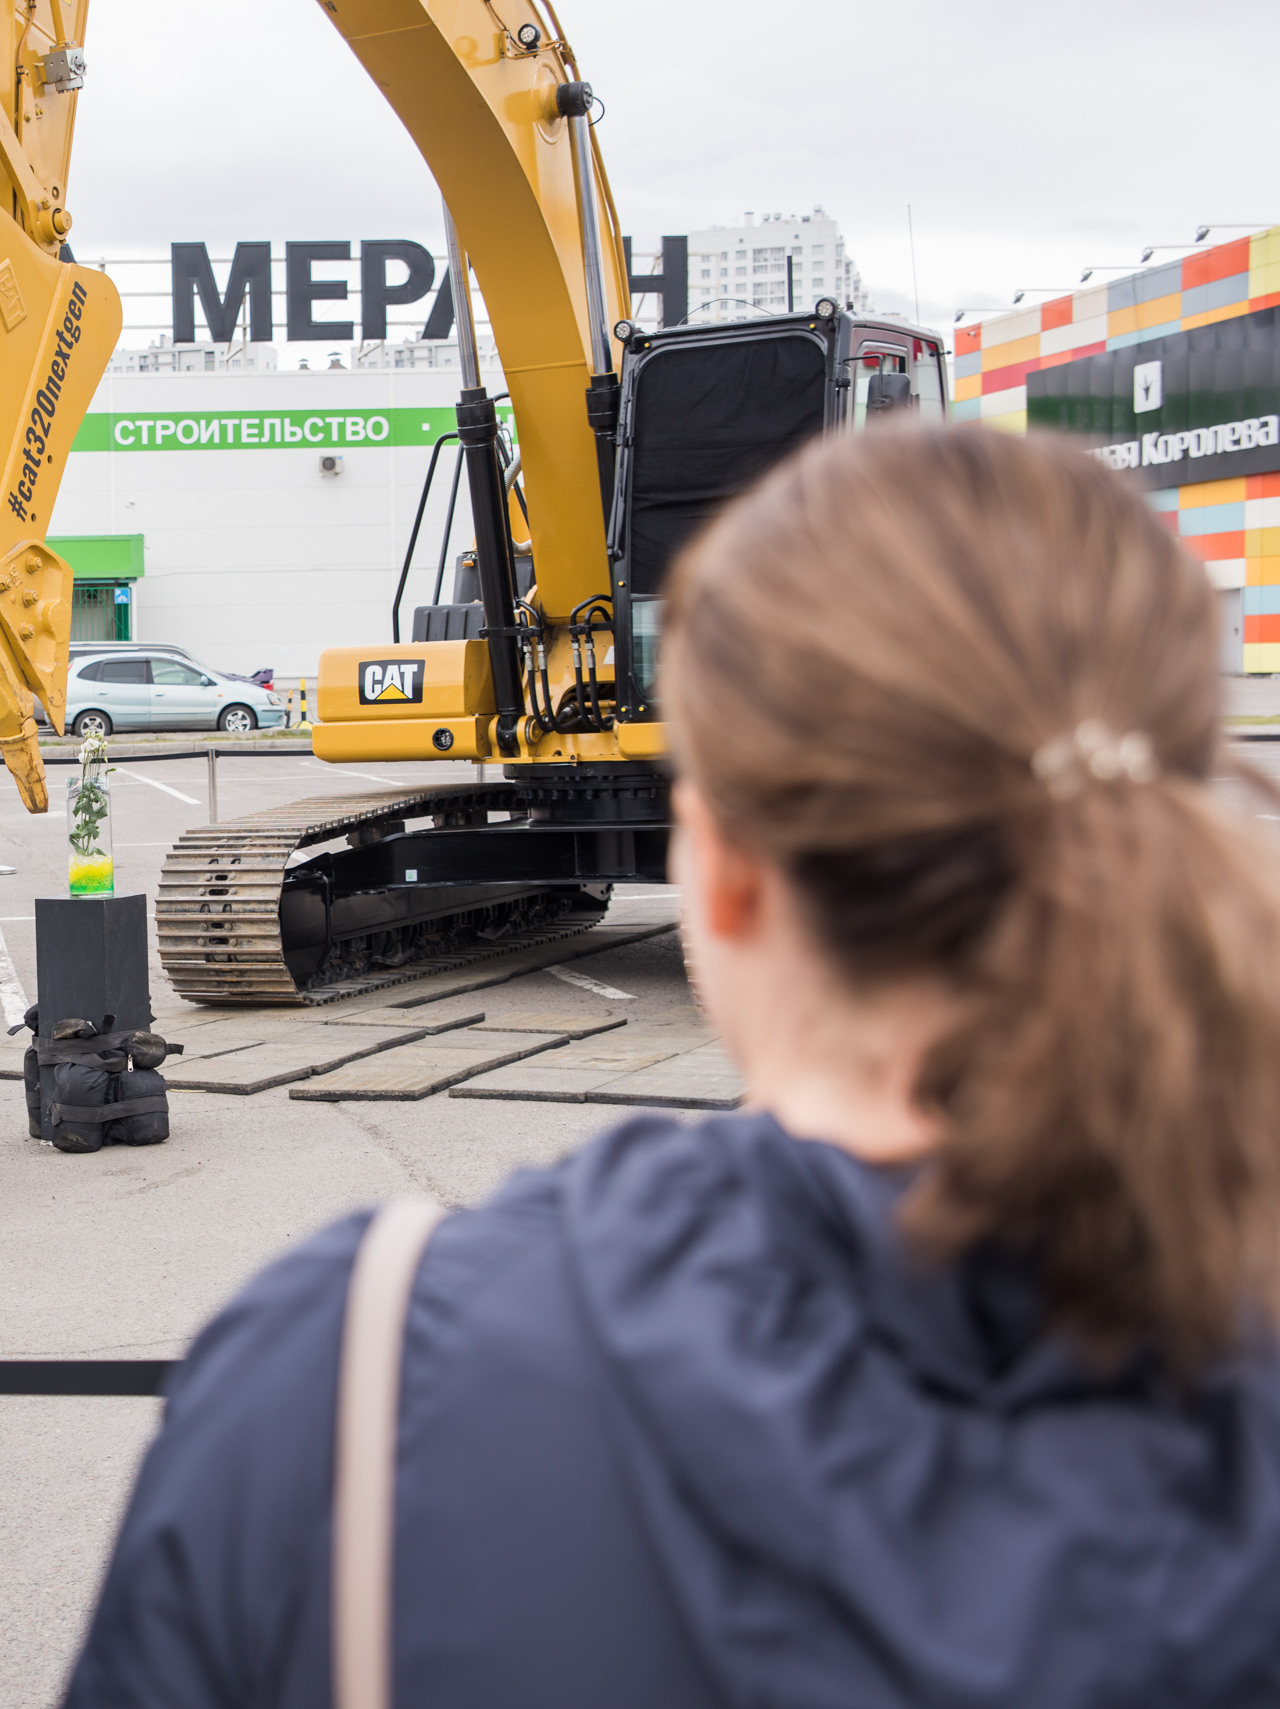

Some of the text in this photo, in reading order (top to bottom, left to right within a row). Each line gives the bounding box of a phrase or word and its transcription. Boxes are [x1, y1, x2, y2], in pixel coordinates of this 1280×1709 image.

[170, 236, 688, 343] МЕРН
[8, 281, 87, 522] #cat320nextgen
[114, 416, 389, 446] СТРОИТЕЛЬСТВО
[1084, 441, 1140, 470] ная
[364, 664, 418, 700] CAT
